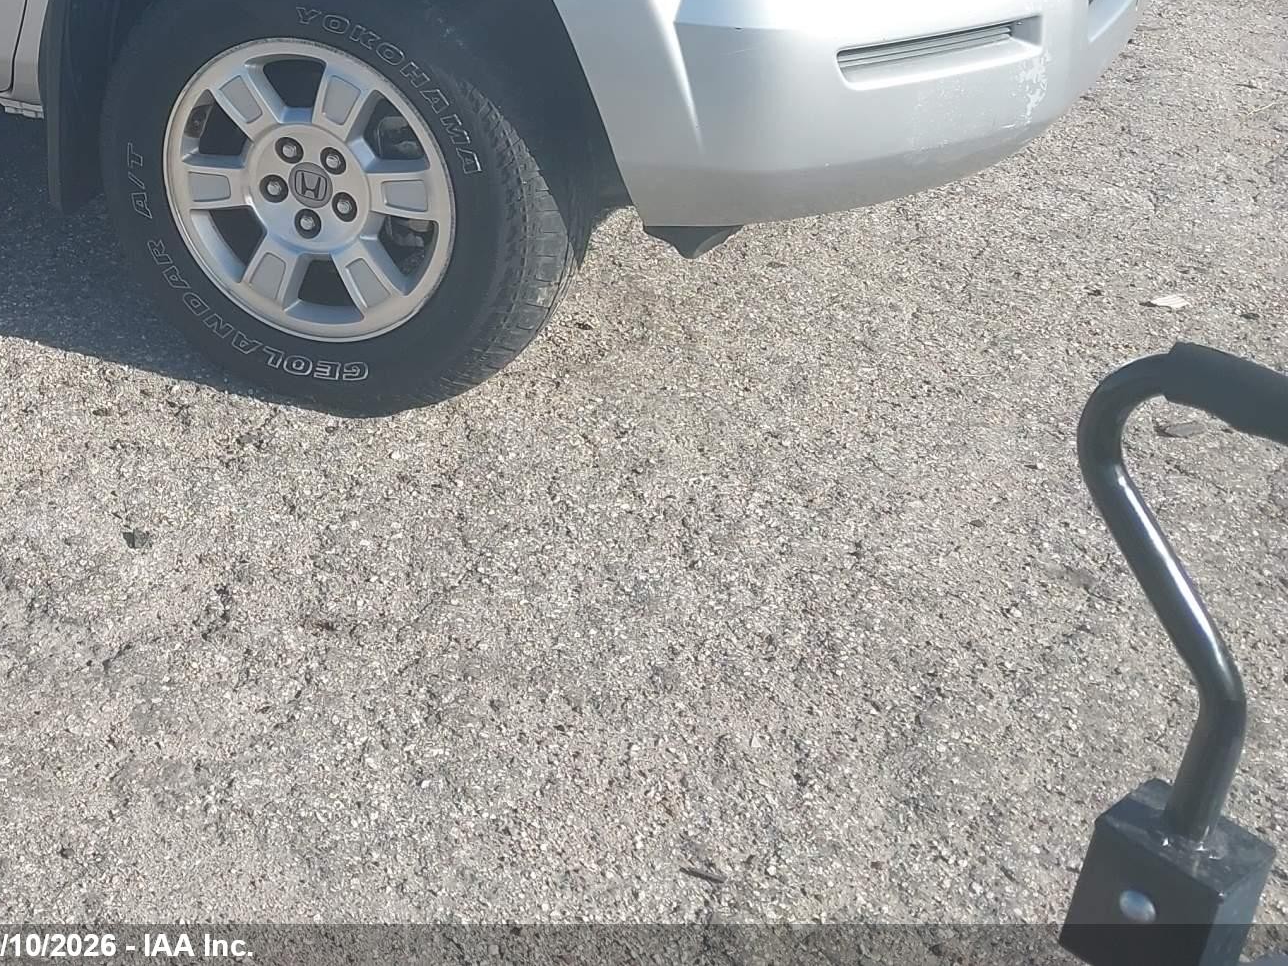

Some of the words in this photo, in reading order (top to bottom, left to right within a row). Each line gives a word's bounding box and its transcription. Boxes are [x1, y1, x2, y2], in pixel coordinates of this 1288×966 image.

[296, 6, 483, 175] YOKOHAMA
[126, 142, 152, 219] A/T
[147, 239, 369, 381] GEOLANDAR
